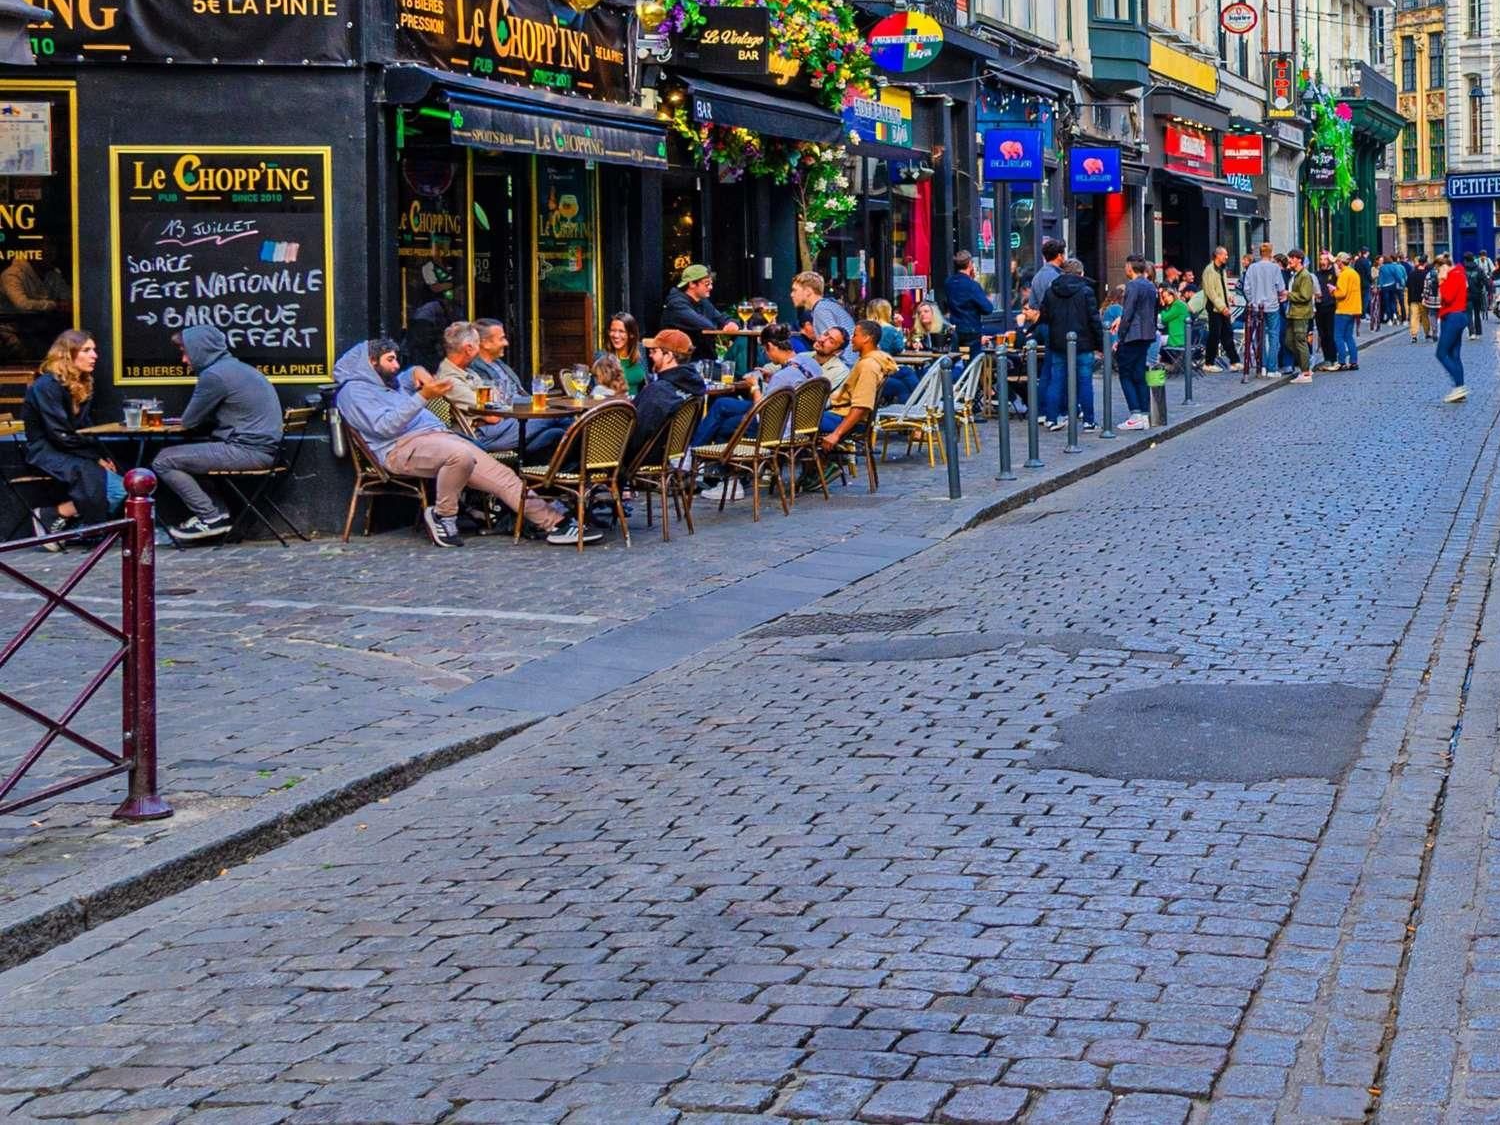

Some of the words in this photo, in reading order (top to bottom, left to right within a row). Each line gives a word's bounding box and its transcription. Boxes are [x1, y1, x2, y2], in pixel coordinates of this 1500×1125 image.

[400, 12, 445, 35] PRESSION
[701, 29, 719, 44] Le
[721, 29, 764, 48] Vintage
[473, 56, 494, 74] PUB
[738, 50, 759, 61] BAR
[696, 100, 713, 120] BAR
[132, 160, 167, 190] Le
[158, 193, 178, 203] PUB
[231, 193, 258, 203] SINCE
[260, 193, 283, 203] 2010
[161, 219, 186, 239] 13
[7, 249, 43, 261] PINTE
[163, 303, 301, 328] BARBECUE
[227, 326, 319, 350] FFERT
[126, 366, 141, 377] 18
[272, 364, 287, 375] LA
[290, 363, 325, 375] PINTE
